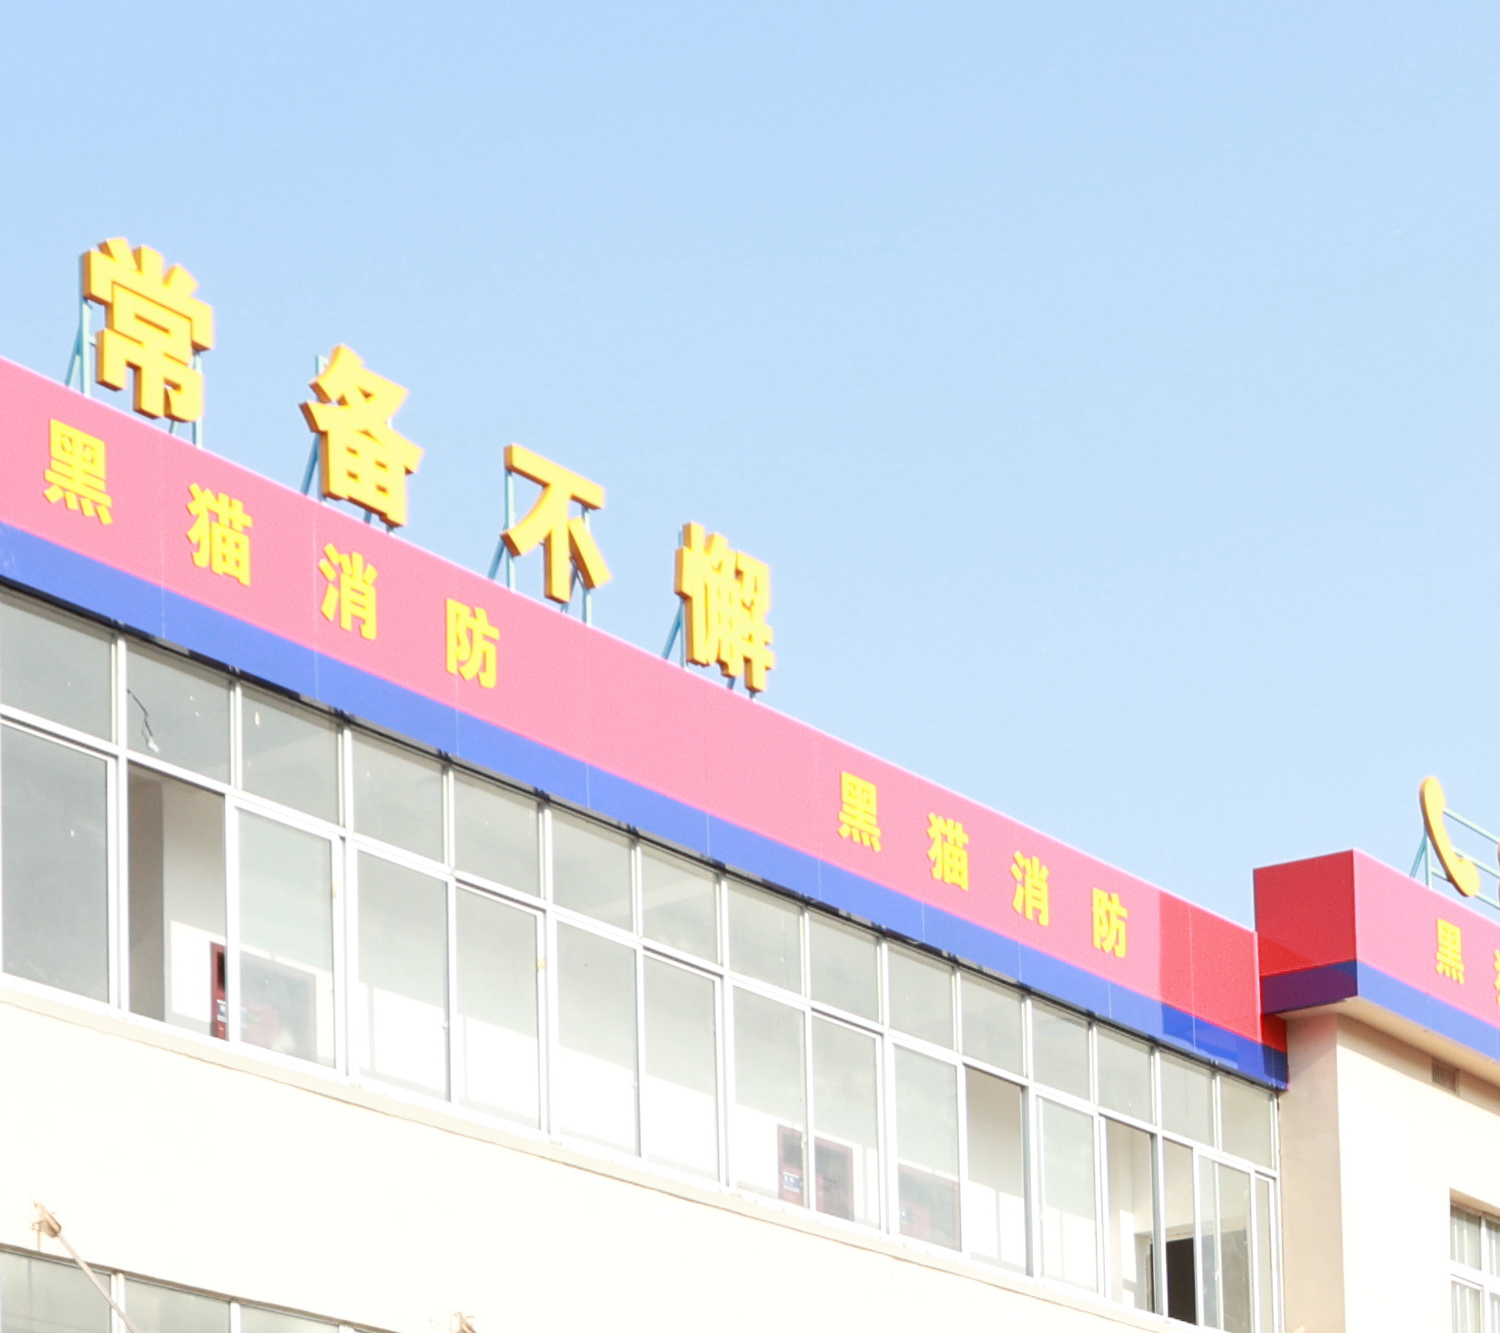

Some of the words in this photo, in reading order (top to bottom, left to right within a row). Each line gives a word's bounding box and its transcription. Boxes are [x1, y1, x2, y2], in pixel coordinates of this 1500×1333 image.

[43, 417, 502, 690] 黑猫消防
[80, 236, 775, 694] 常备不懈
[837, 770, 1130, 960] 黑猫消防
